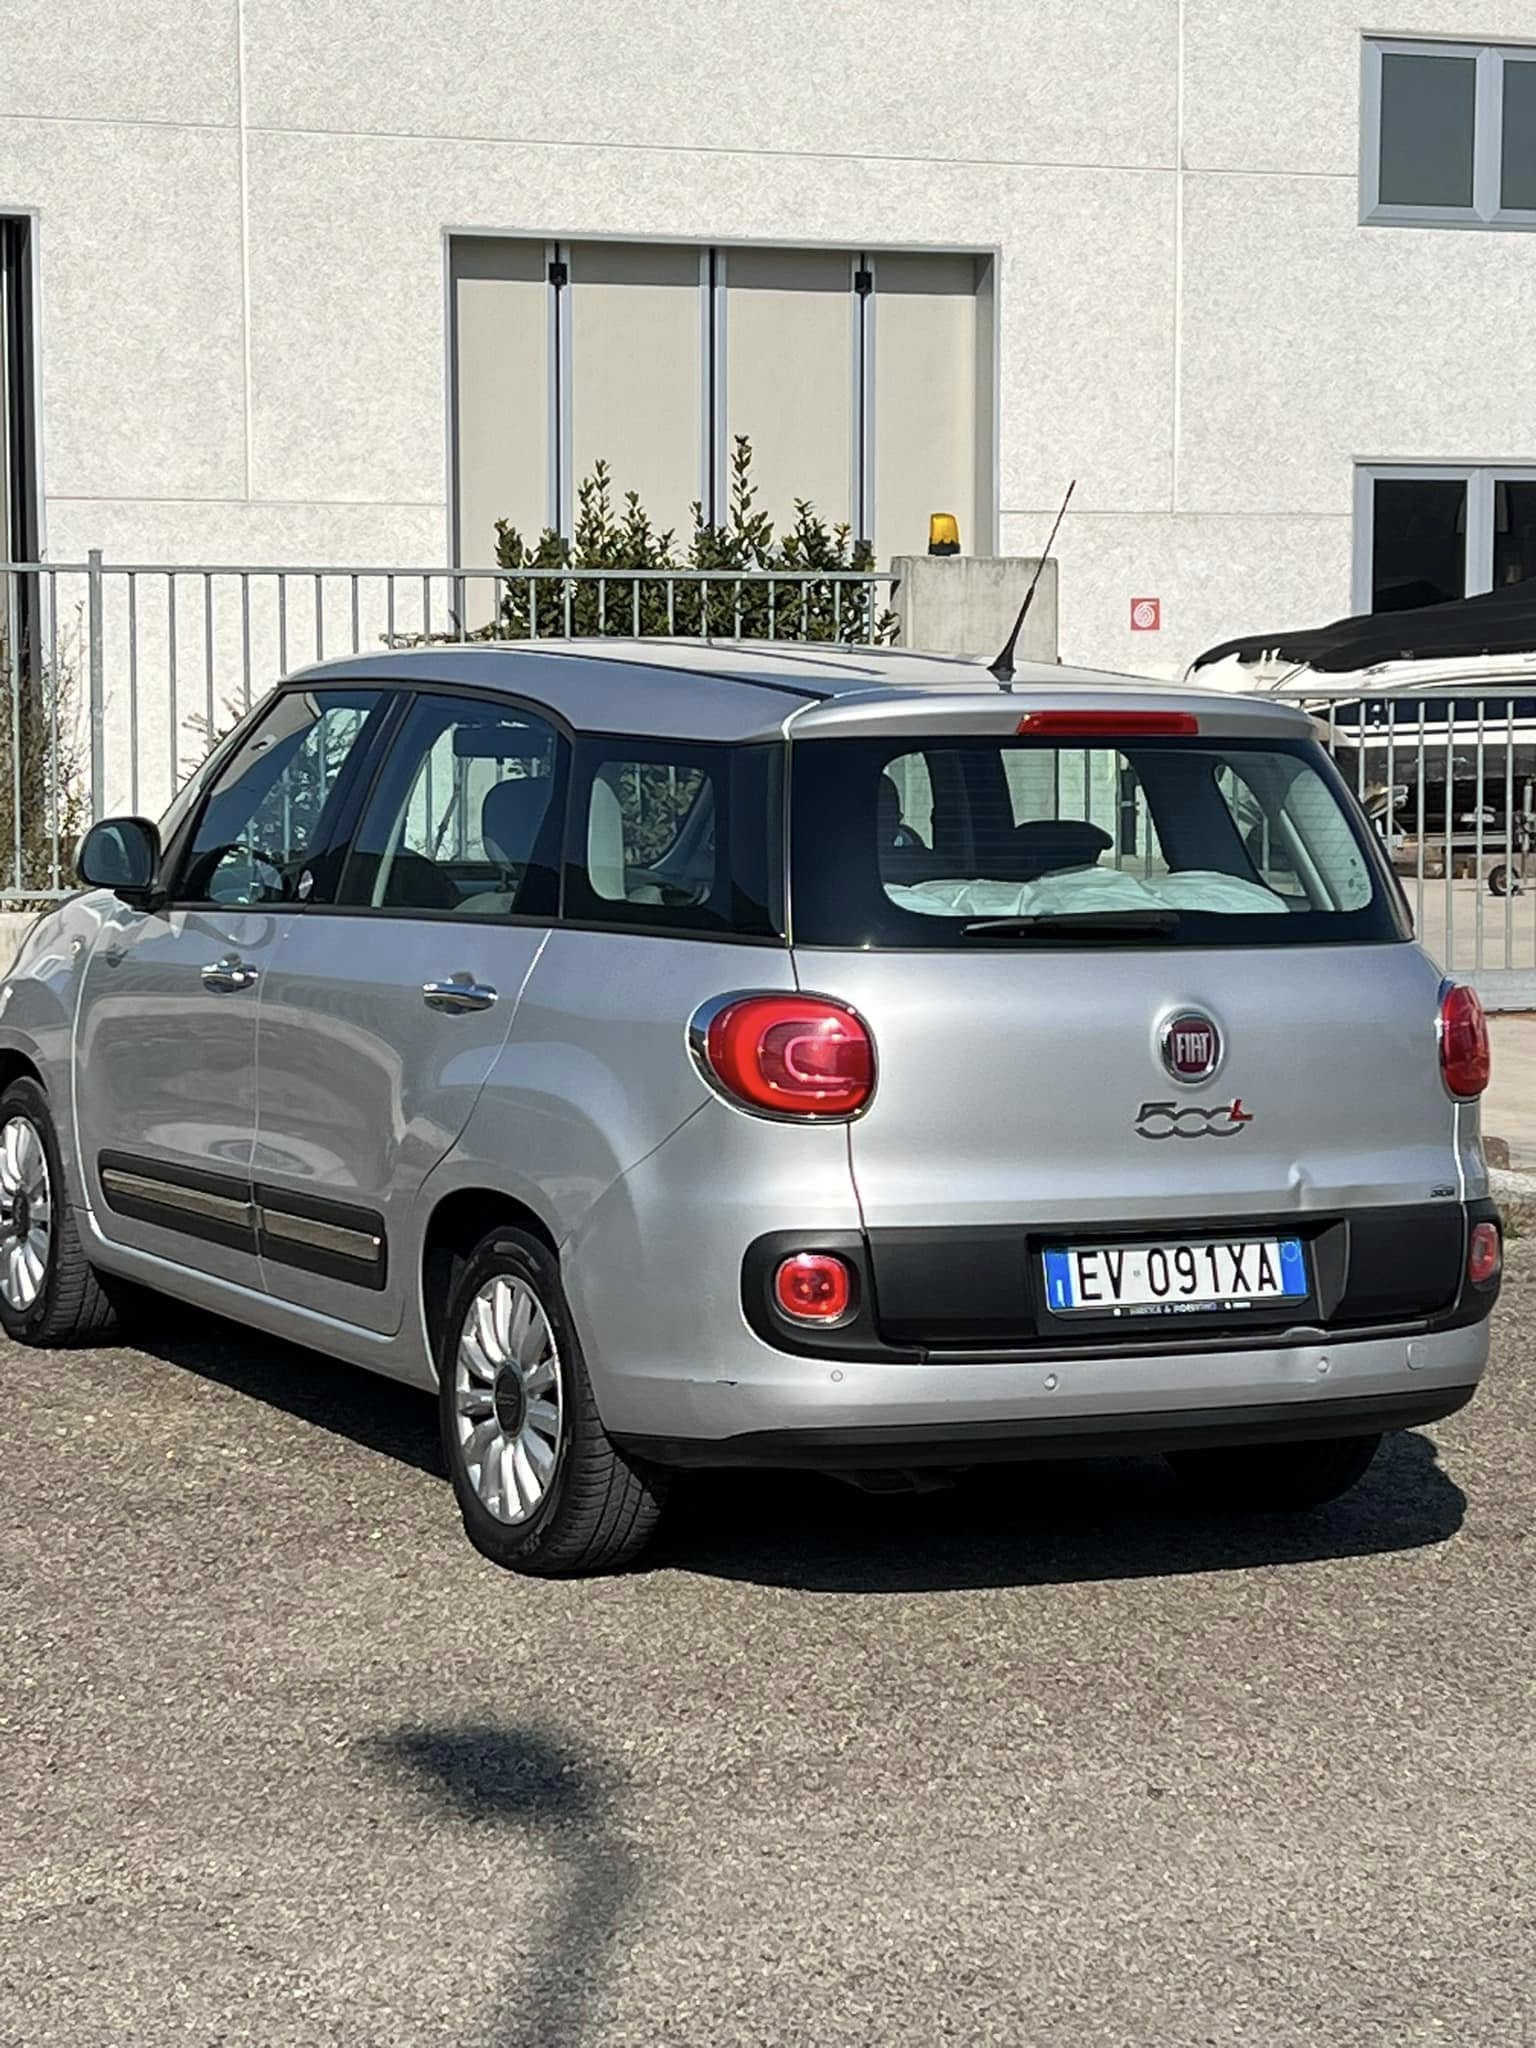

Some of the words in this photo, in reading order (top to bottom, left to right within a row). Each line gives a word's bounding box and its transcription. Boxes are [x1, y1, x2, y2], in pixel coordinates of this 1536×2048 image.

[1176, 1032, 1210, 1064] FIAT
[1134, 1099, 1253, 1139] 500L
[1076, 1249, 1124, 1301] EV
[1147, 1243, 1278, 1296] 091XA
